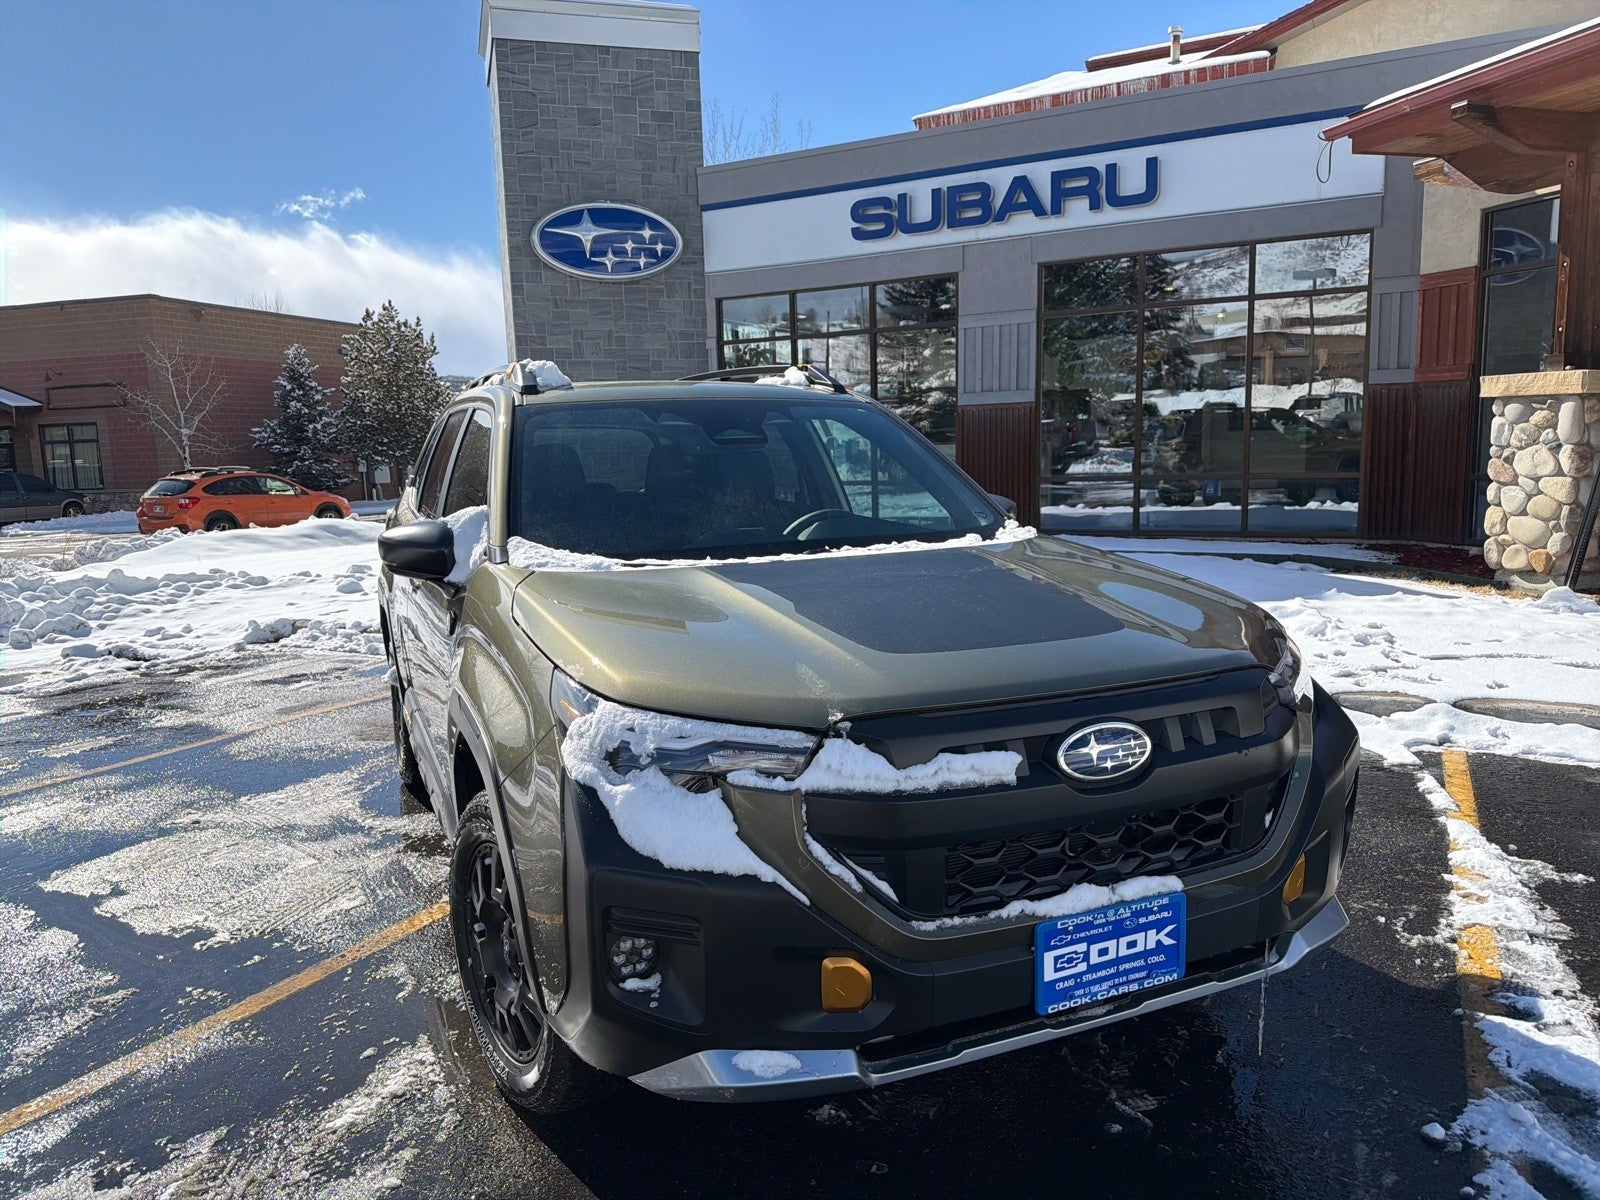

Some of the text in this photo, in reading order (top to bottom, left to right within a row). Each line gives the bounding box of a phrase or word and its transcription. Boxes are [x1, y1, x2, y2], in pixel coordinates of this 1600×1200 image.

[850, 156, 1159, 241] SUBARU
[1117, 898, 1170, 914] ALTITUDE
[1138, 911, 1172, 924] SUBARU
[1072, 926, 1113, 940] CHEVROLET
[1043, 924, 1178, 982] COOK
[1055, 954, 1166, 990] CRAIG STEAMBOAT SPRINGS, COLO.
[1047, 973, 1178, 1014] COOK-CARS.COM
[466, 990, 509, 1080] YOKOHAMA
